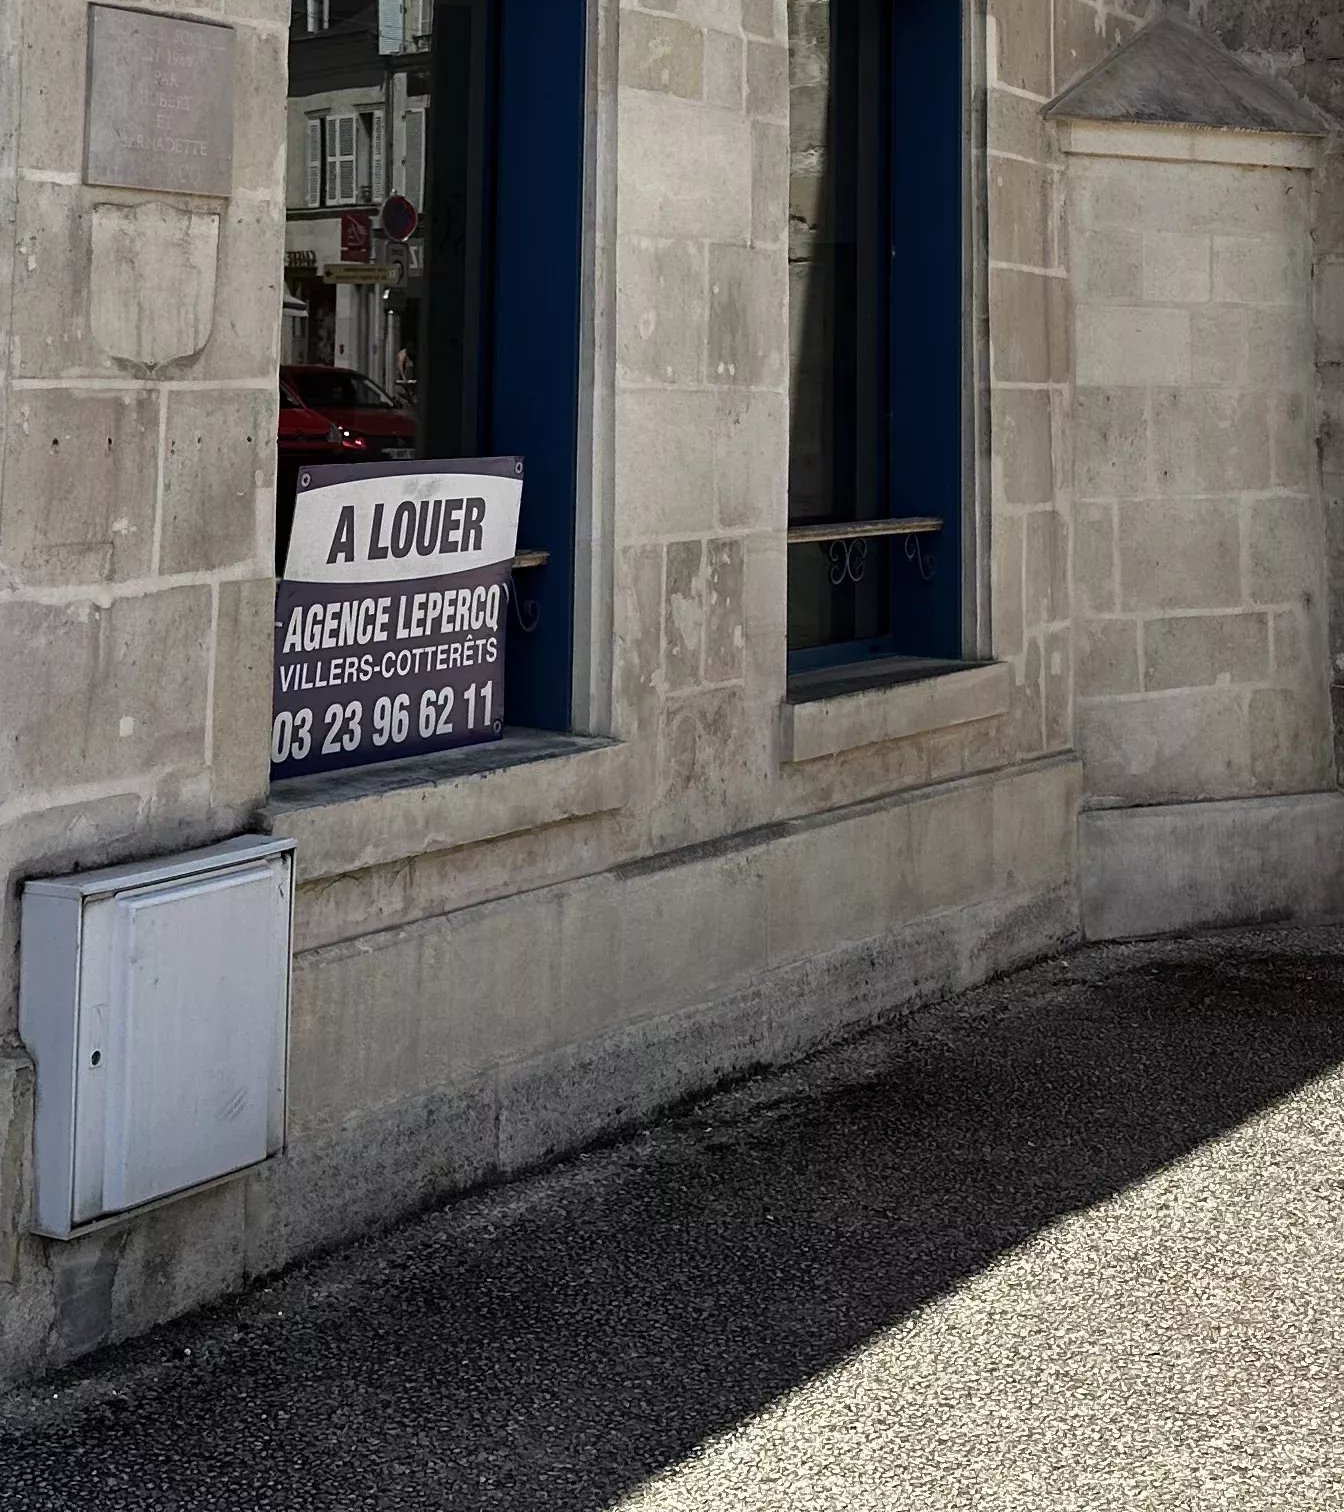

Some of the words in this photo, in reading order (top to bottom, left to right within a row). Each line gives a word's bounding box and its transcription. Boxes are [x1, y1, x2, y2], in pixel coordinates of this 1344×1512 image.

[325, 505, 356, 564] A
[367, 497, 487, 560] LOUER
[282, 596, 391, 654] AGENCE
[395, 584, 501, 640] LEPERCQ
[279, 634, 498, 692] VILLERS-COTTERÊTS
[270, 707, 313, 763] 03
[321, 700, 363, 755] 23
[372, 693, 410, 746] 96
[418, 686, 454, 738] 62
[463, 680, 494, 729] 11
